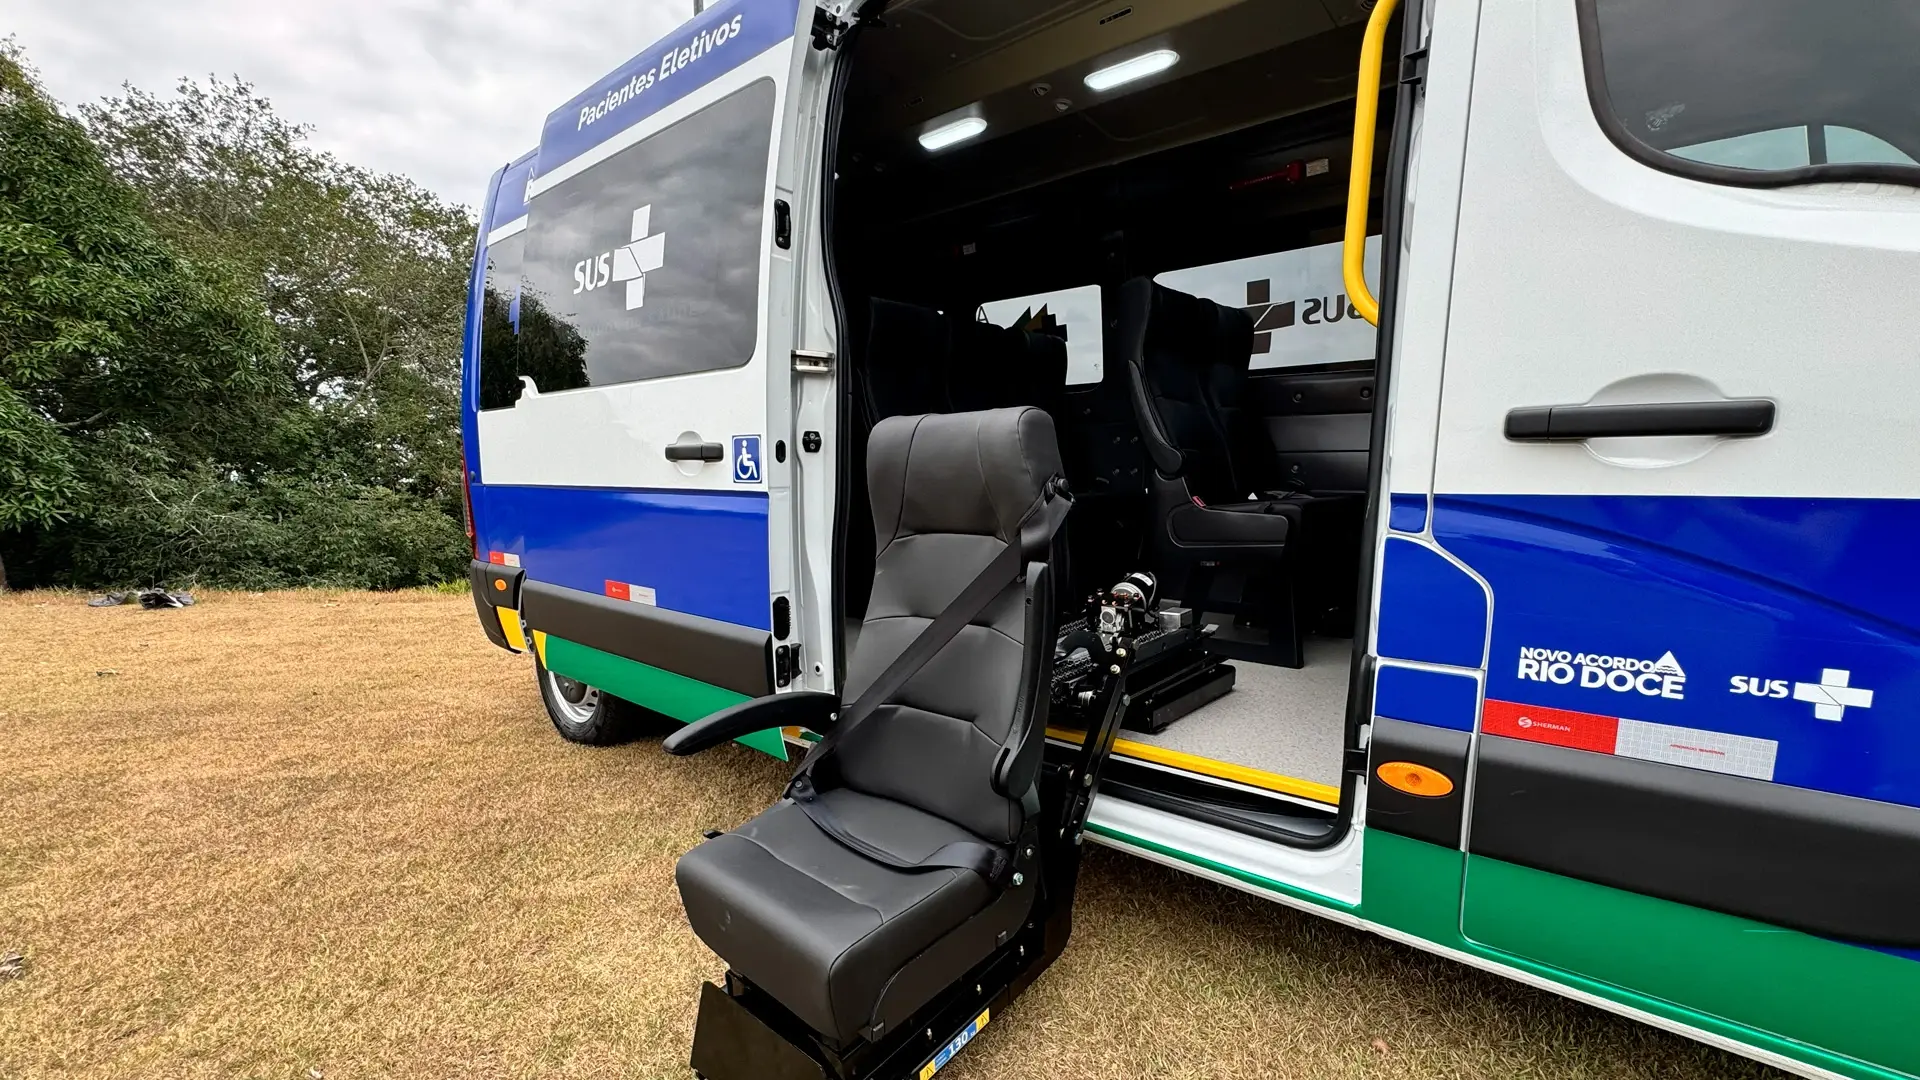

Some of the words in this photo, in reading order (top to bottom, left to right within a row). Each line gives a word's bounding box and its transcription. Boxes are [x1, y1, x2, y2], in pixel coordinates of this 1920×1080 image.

[577, 69, 656, 131] Pacientes
[658, 14, 742, 81] Eletivos
[573, 252, 610, 295] SUS
[1520, 646, 1572, 663] NOVO
[1573, 652, 1656, 673] ACORDO
[1517, 658, 1575, 685] RIO
[1580, 665, 1687, 700] DOCE
[1729, 675, 1789, 699] SUS
[1532, 720, 1571, 732] SHERMAN
[948, 1031, 969, 1057] 130
